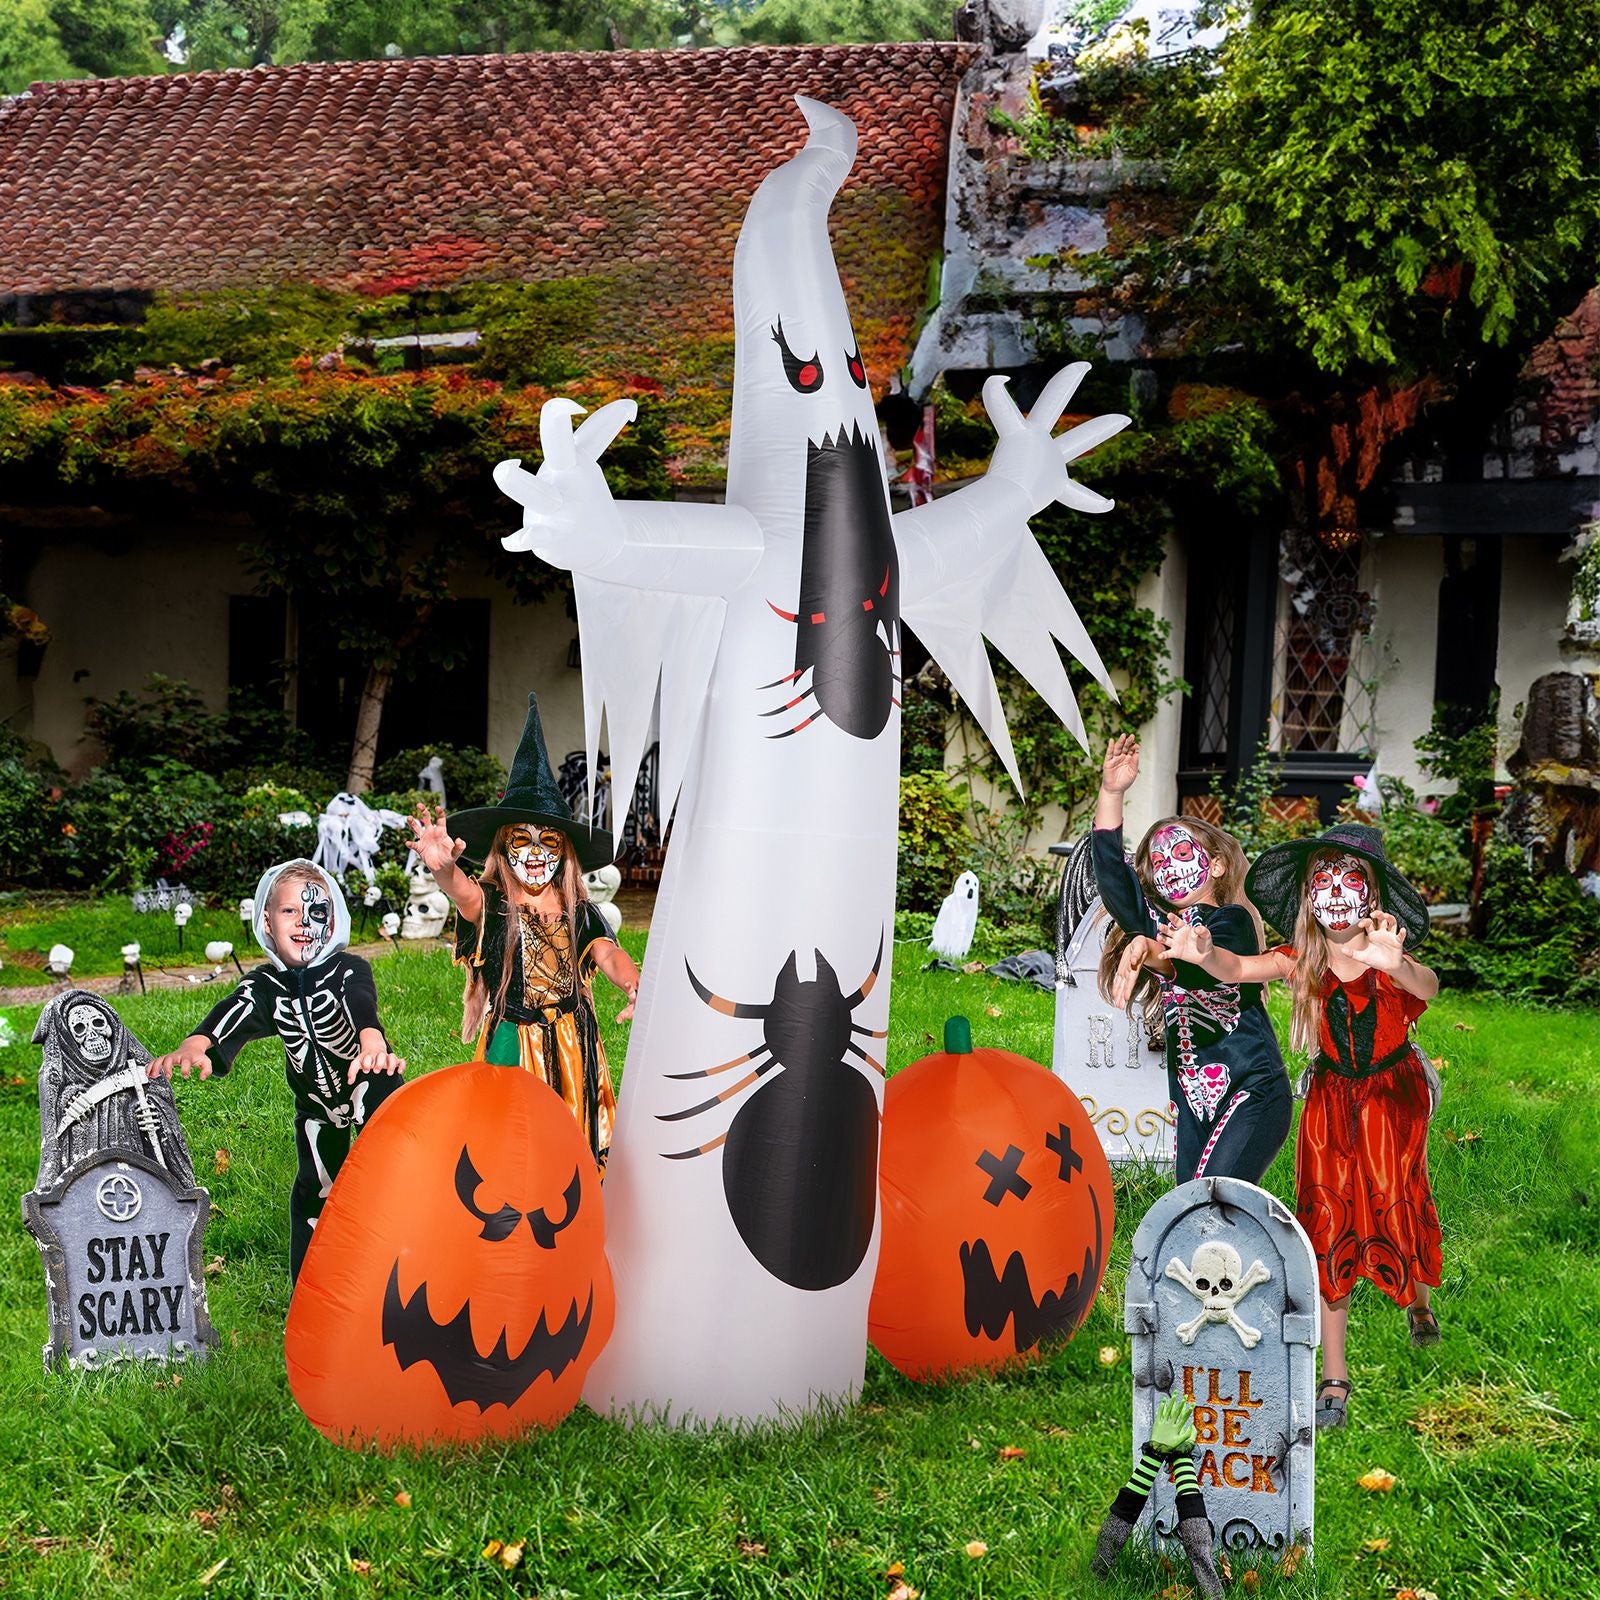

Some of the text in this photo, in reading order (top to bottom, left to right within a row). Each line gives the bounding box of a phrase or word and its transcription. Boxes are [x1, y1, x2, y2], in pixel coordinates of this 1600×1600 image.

[1086, 1014, 1167, 1069] RI
[87, 1233, 169, 1284] STAY
[78, 1285, 183, 1341] SCARY
[1182, 1366, 1263, 1408] I'LL
[1192, 1405, 1252, 1448] BE
[1168, 1450, 1278, 1494] ACK
